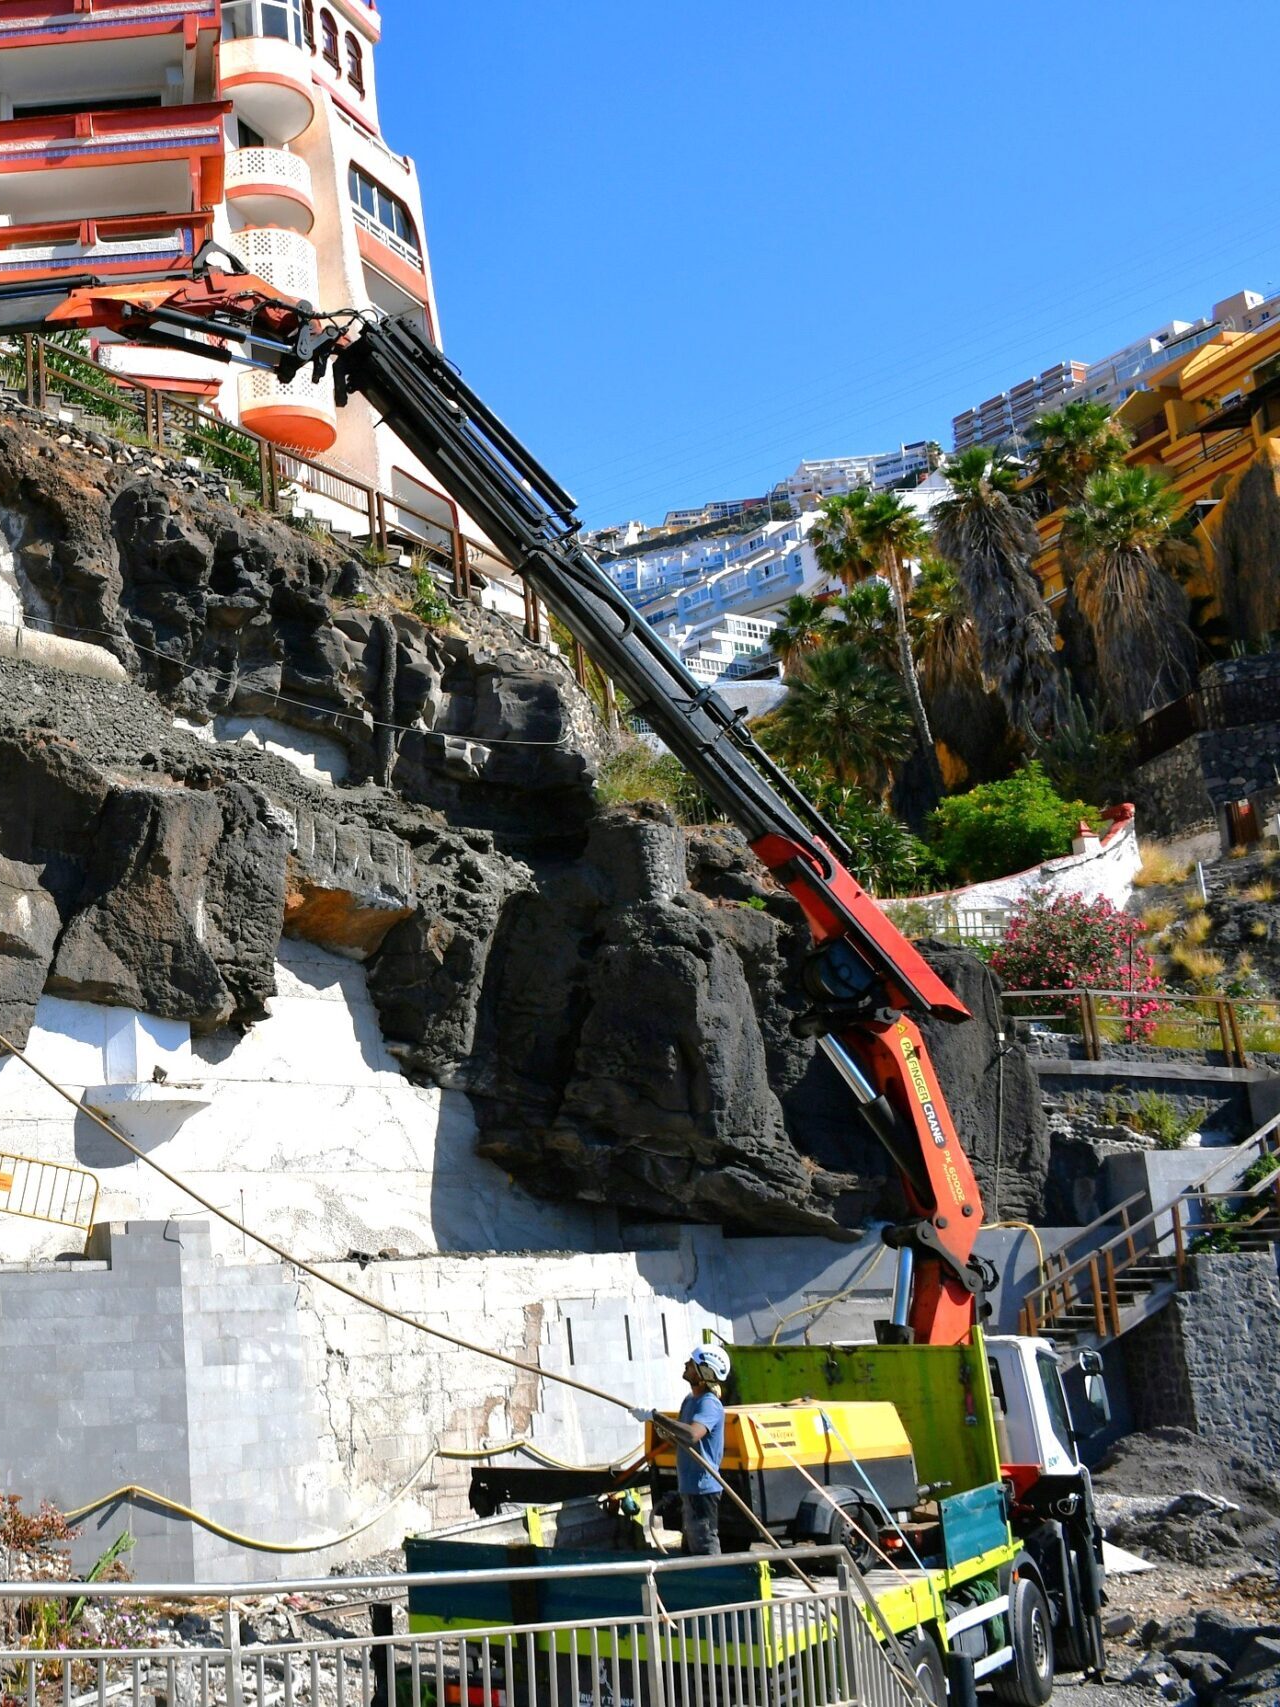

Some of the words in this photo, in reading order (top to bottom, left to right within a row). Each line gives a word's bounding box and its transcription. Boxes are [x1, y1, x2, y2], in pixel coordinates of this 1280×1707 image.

[923, 1103, 944, 1144] CRANE
[943, 1150, 953, 1164] PK
[948, 1166, 966, 1202] 60002
